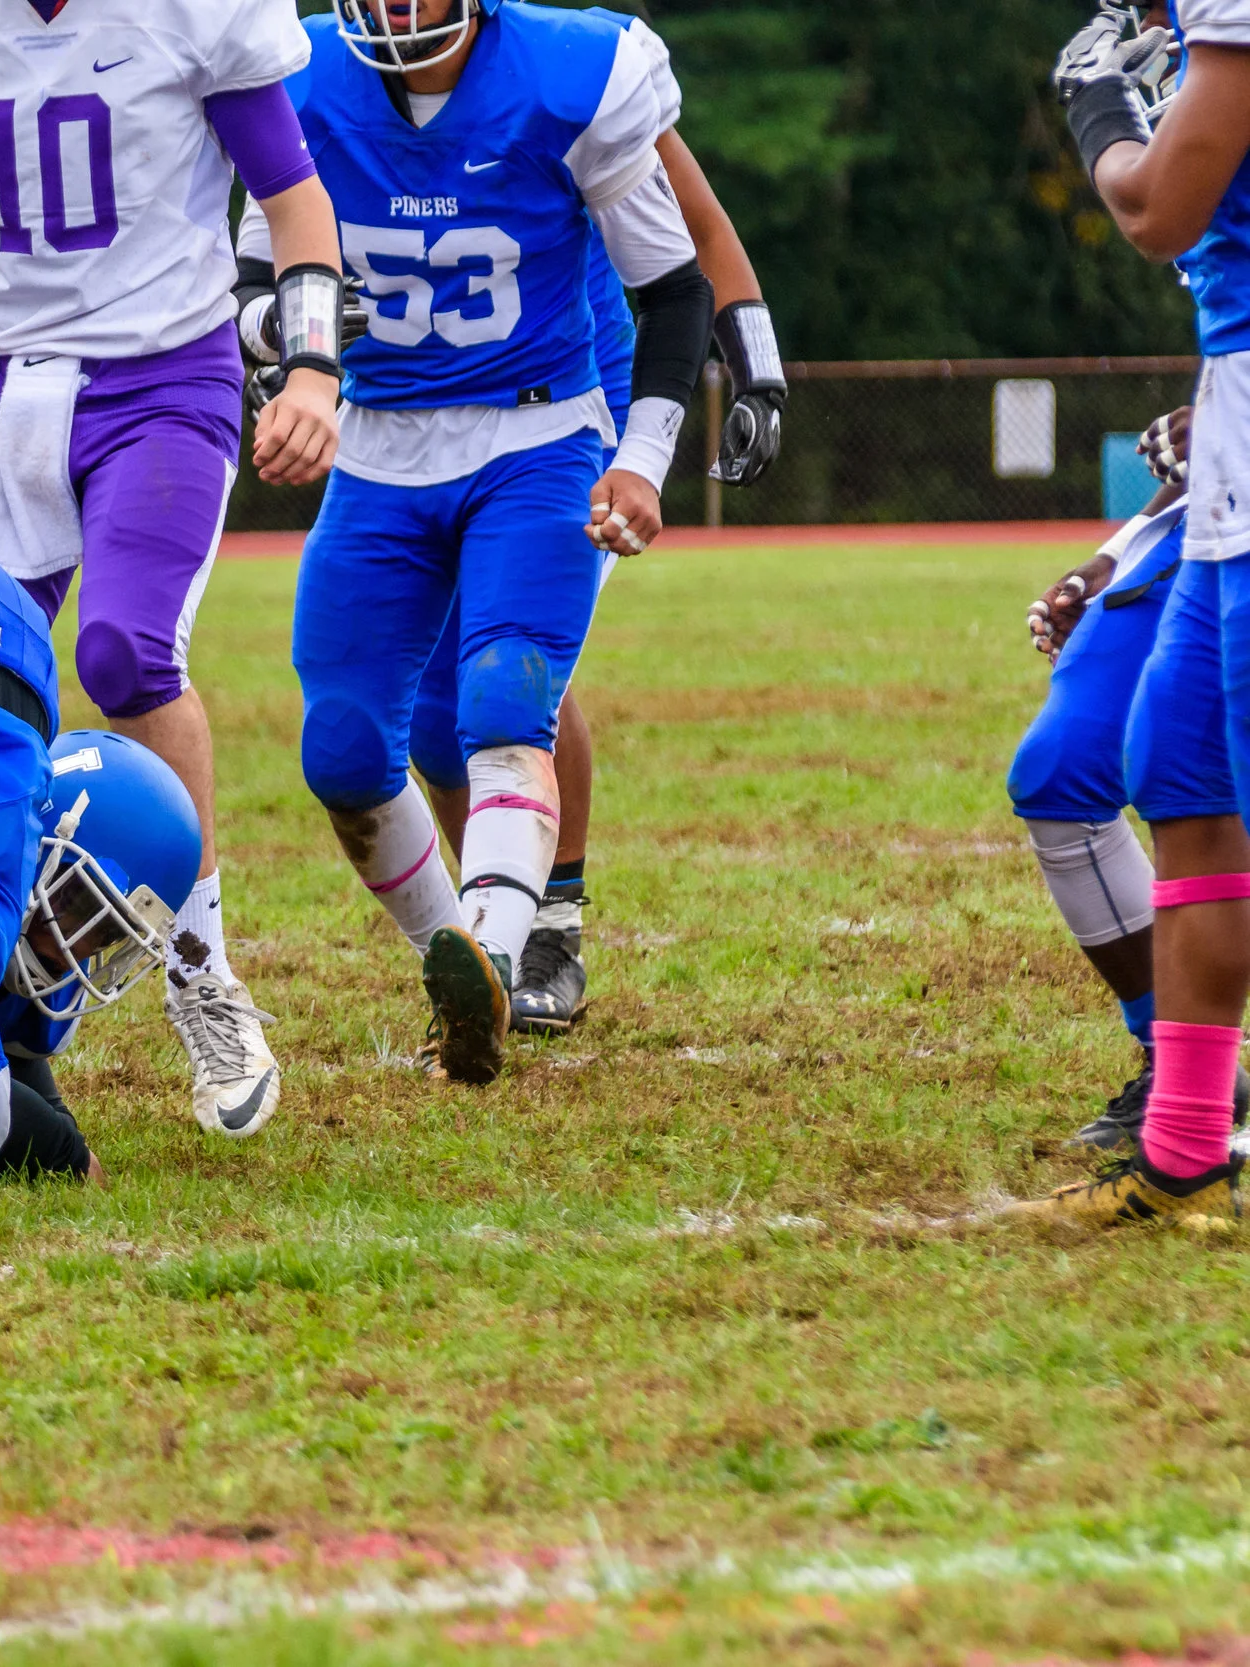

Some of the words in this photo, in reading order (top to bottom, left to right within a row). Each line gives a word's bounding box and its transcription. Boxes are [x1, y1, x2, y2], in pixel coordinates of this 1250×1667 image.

[389, 195, 459, 217] PINERS
[340, 220, 522, 348] 53
[530, 390, 539, 401] L
